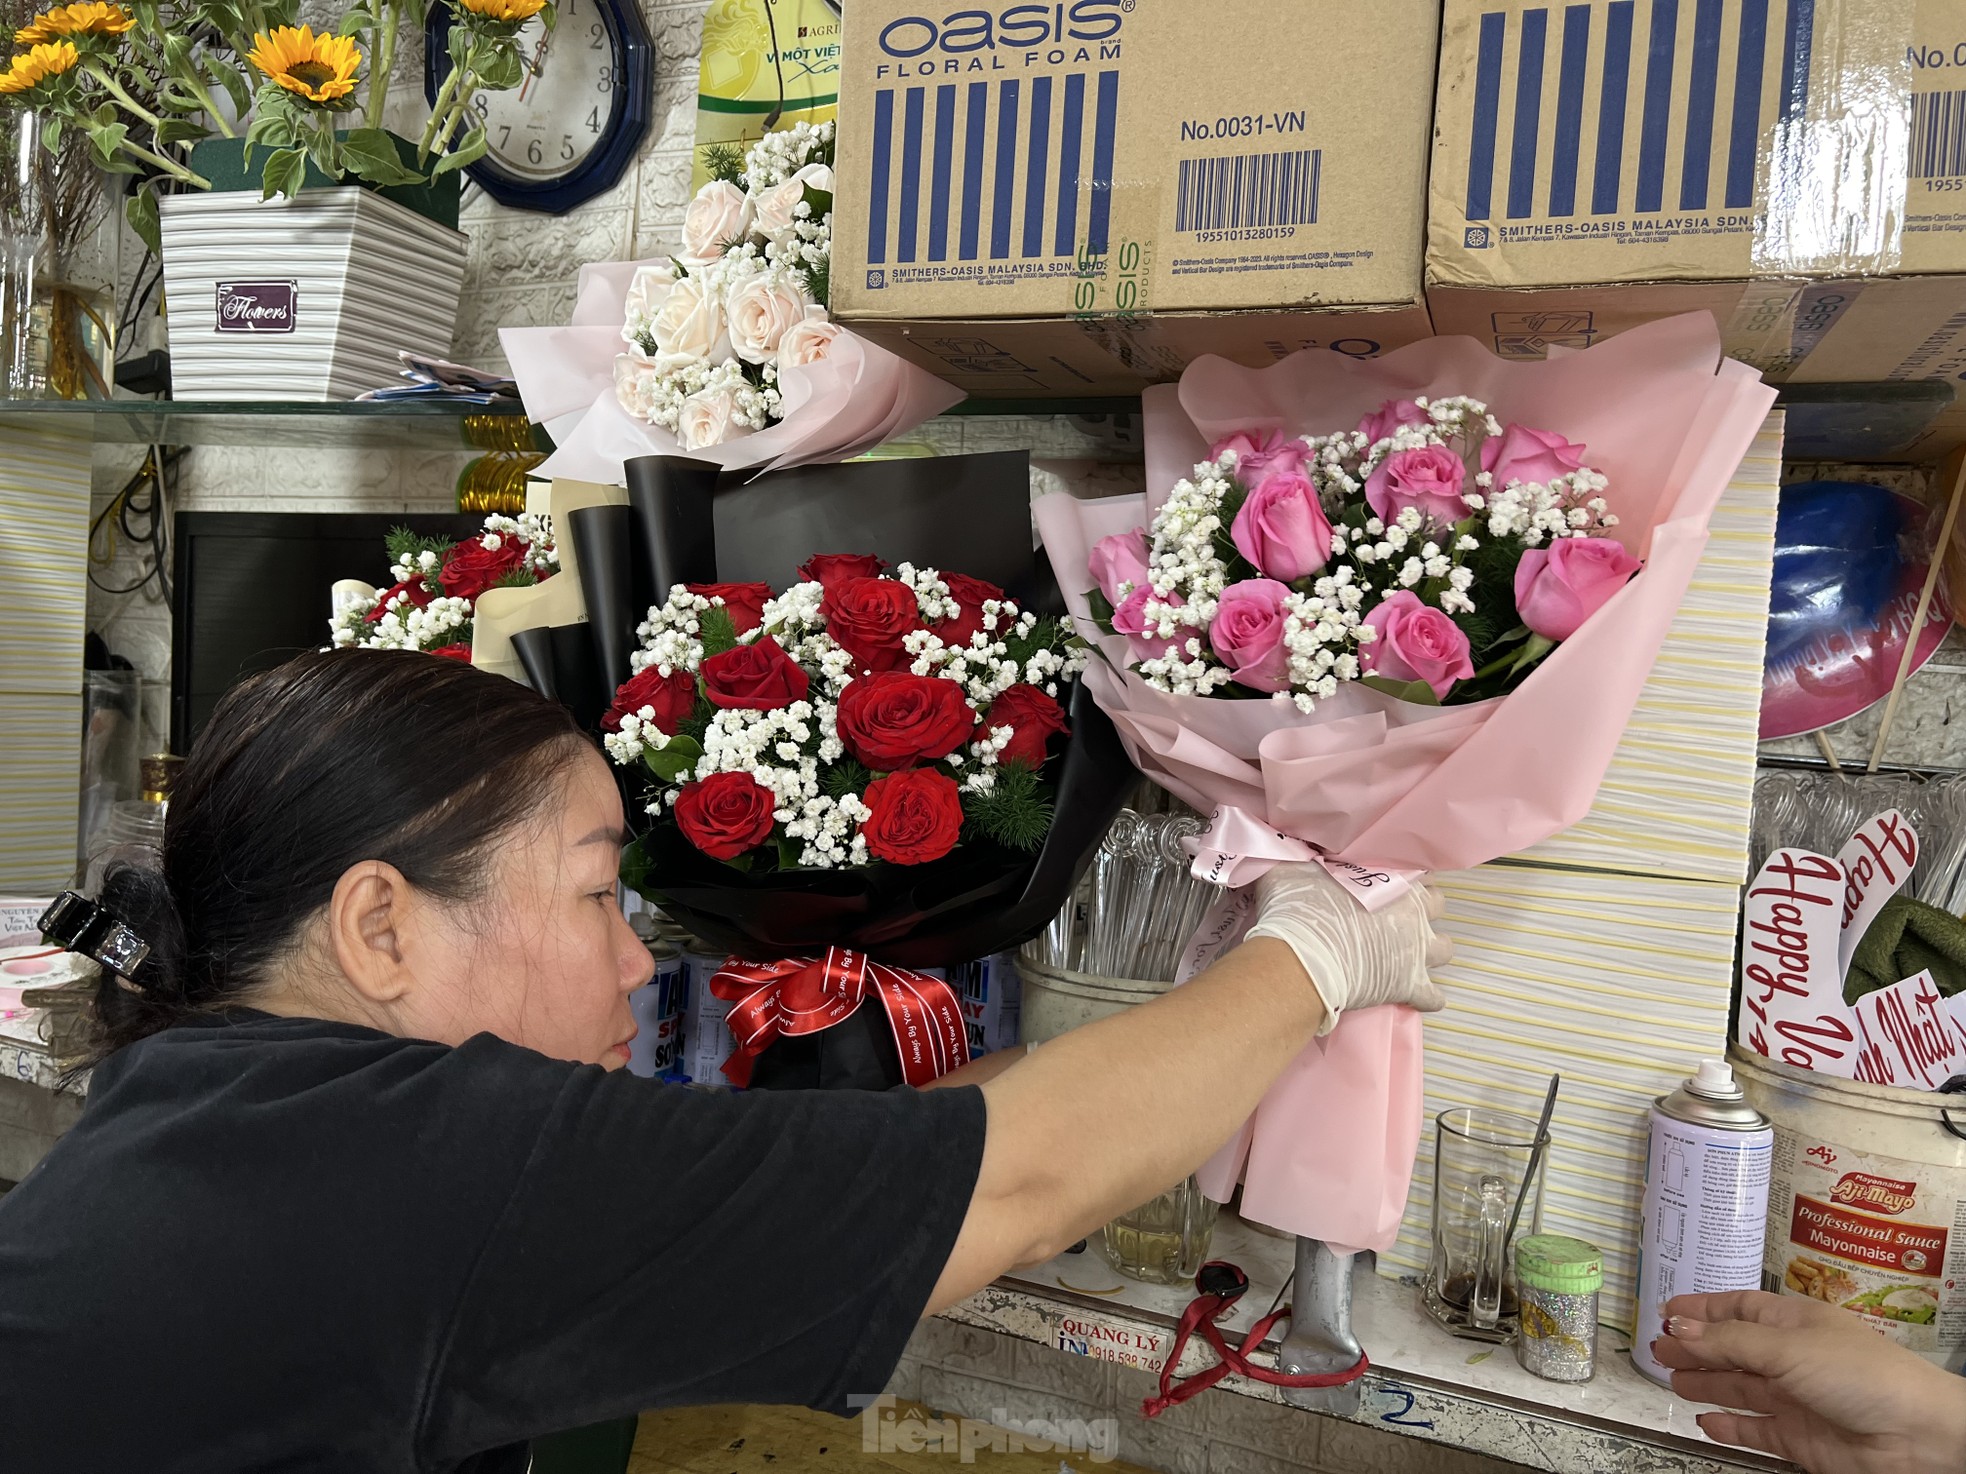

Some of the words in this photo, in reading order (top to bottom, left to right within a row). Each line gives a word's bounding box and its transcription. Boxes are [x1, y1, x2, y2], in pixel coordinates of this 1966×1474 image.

[590, 23, 605, 50] 2
[809, 25, 839, 37] AGRI
[788, 59, 839, 83] Xa
[877, 56, 1005, 79] FLORAL
[1025, 44, 1121, 67] FOAM
[597, 66, 612, 93] 3
[475, 94, 489, 119] 8
[585, 105, 601, 134] 4
[499, 125, 512, 150] 7
[1181, 111, 1305, 141] No.0031-VN
[527, 139, 543, 165] 6
[560, 134, 575, 160] 5
[1925, 178, 1966, 192] 1955
[1195, 227, 1295, 242] 19551013280159
[1500, 221, 1626, 236] SMITHERS-OASIS
[1633, 217, 1709, 230] MALAYSIA
[1717, 215, 1753, 226] SDN.
[892, 266, 984, 278] SMITHERS-OASIS
[988, 262, 1044, 274] MALAYSIA
[1048, 262, 1075, 272] SDN.
[1140, 241, 1152, 307] RODUCTS
[223, 294, 288, 321] Flowers
[741, 960, 759, 969] Your
[762, 963, 779, 974] Side
[750, 996, 775, 1018] Always
[1876, 977, 1957, 1088] Nhật
[1855, 1173, 1906, 1191] Mayonnaise
[1829, 1179, 1918, 1213] Aji-Mayo
[1798, 1206, 1894, 1242] Professional
[1895, 1232, 1941, 1250] Sauce
[1809, 1229, 1896, 1263] Mayonnaise
[1063, 1319, 1130, 1346] QUANG
[1136, 1335, 1160, 1352] LÝ
[1379, 1389, 1434, 1431] 2
